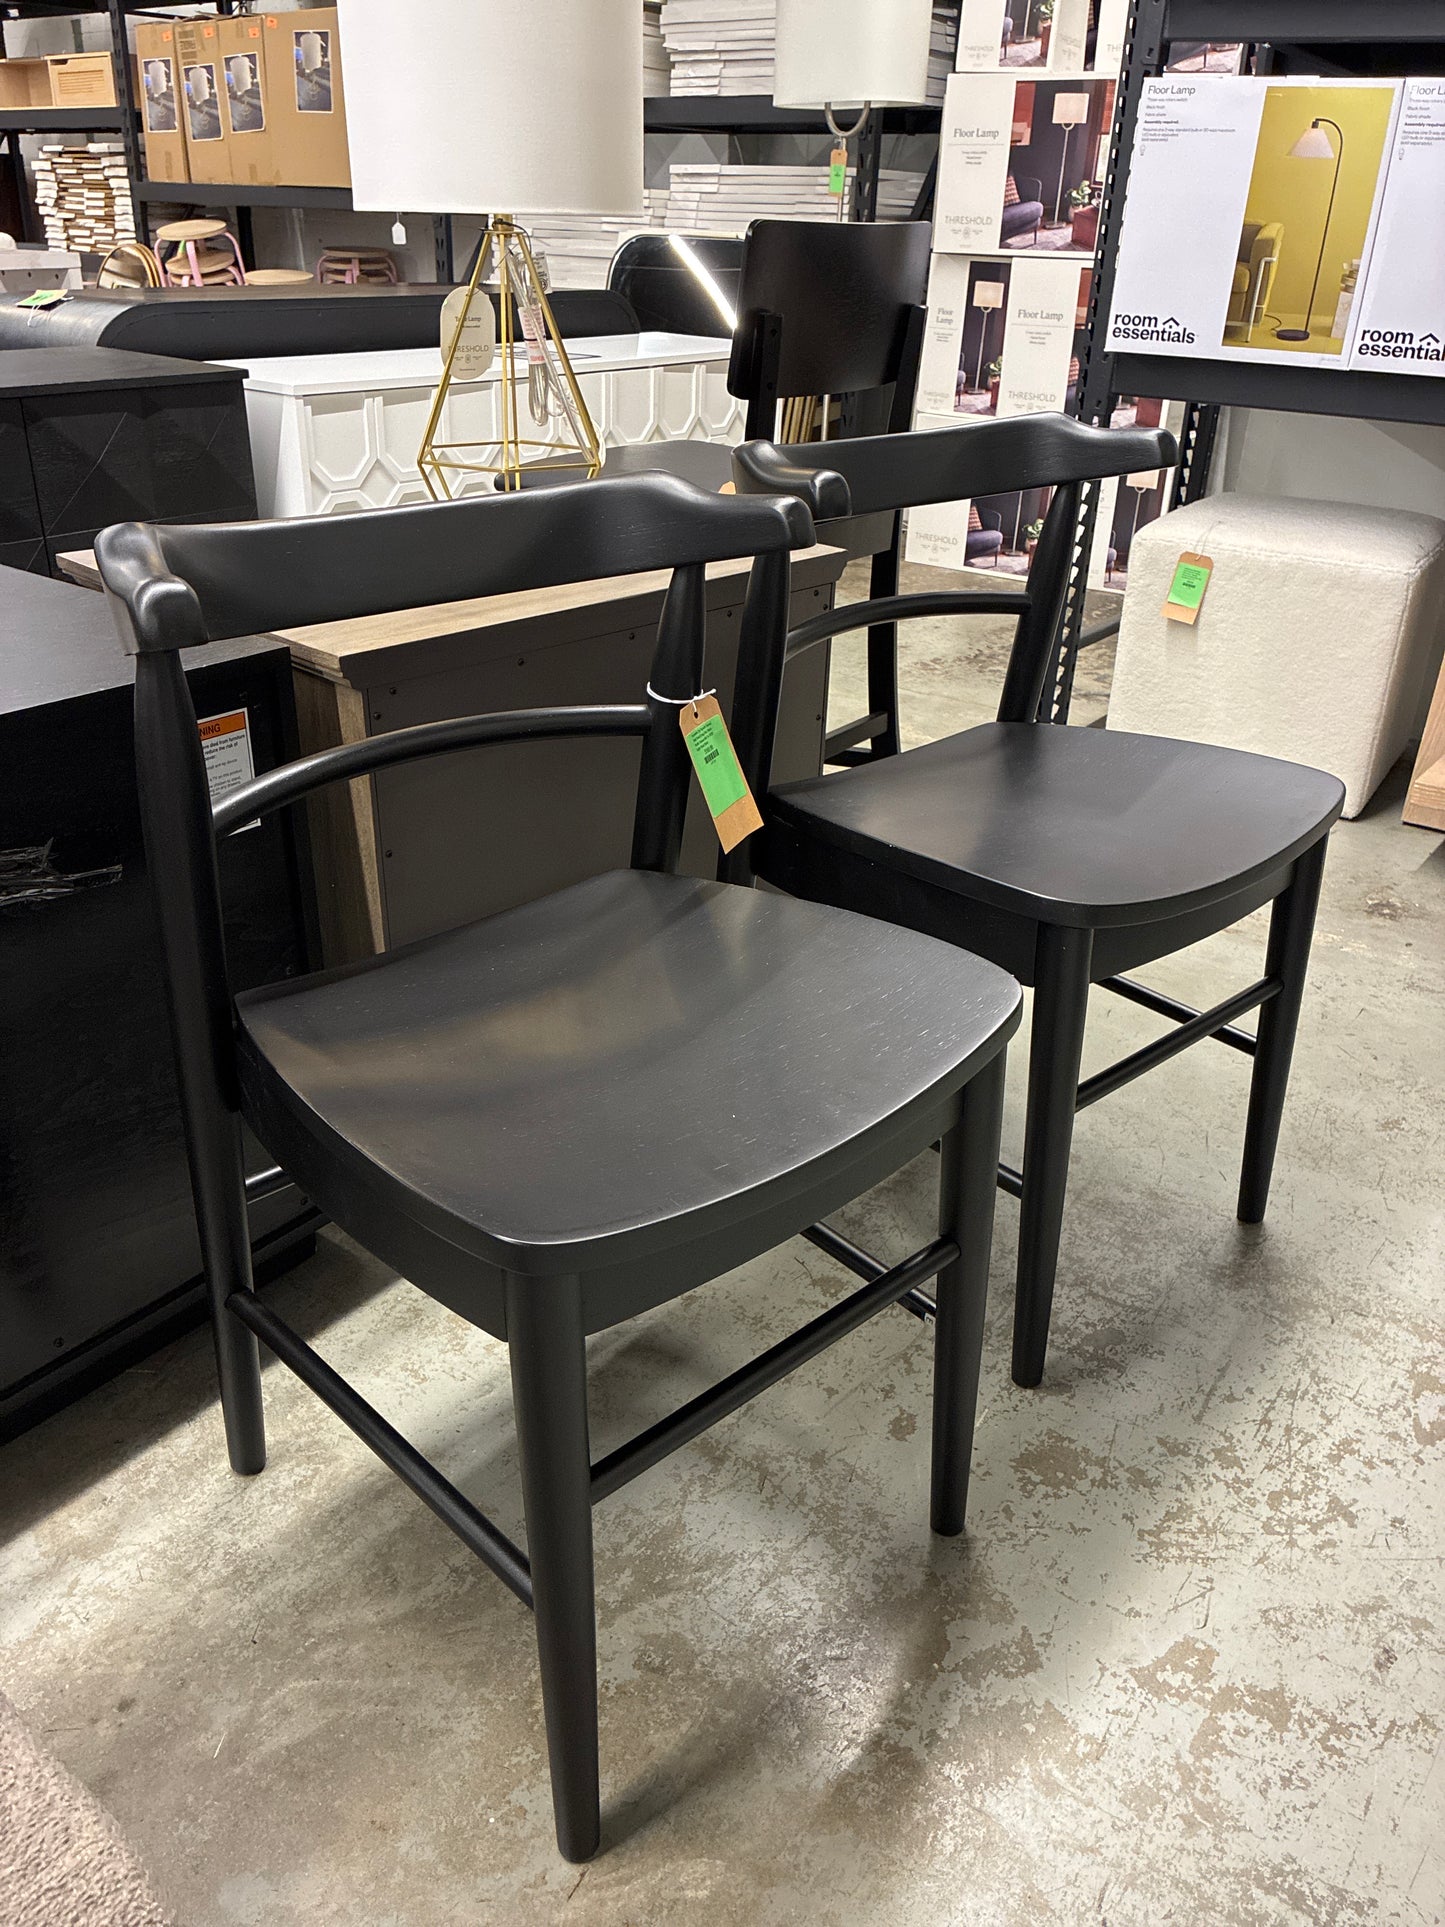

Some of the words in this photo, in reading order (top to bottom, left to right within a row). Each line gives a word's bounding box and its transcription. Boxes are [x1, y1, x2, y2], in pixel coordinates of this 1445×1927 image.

[1148, 85, 1170, 95] Floor
[1171, 85, 1196, 97] Lamp
[1410, 85, 1436, 95] Floor
[953, 128, 975, 138] Floor
[976, 128, 999, 140] Lamp
[945, 215, 992, 226] THRESHOLD
[1017, 309, 1039, 319] Floor
[1040, 310, 1064, 322] Lamp
[1114, 313, 1158, 328] room
[1112, 326, 1195, 344] essentials
[1361, 329, 1414, 345] room
[1008, 390, 1056, 403] THRESHOLD
[915, 531, 958, 545] THRESHOLD
[199, 723, 221, 737] NING
